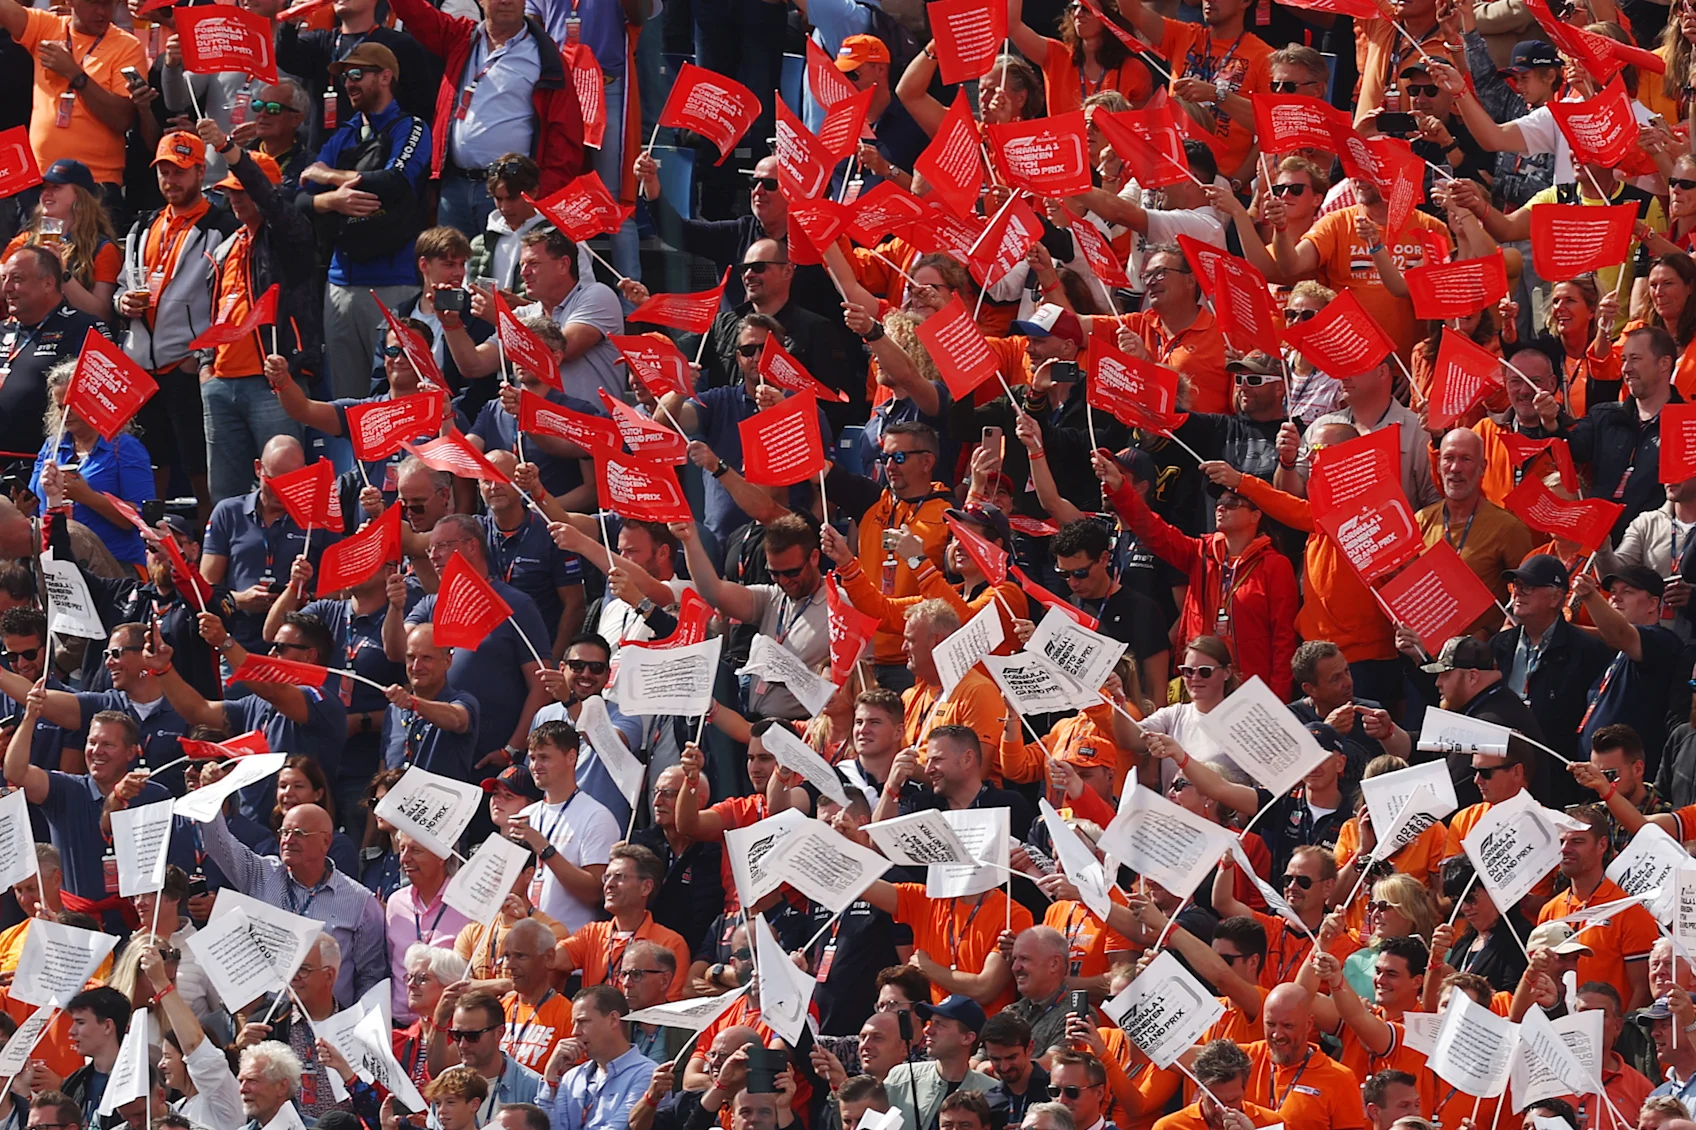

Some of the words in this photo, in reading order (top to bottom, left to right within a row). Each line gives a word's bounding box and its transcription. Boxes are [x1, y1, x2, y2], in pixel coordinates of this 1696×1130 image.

[195, 32, 243, 41] HEINEKEN
[197, 38, 230, 47] DUTCH
[198, 45, 233, 54] GRAND
[233, 48, 253, 56] PRIX
[717, 116, 737, 136] PRIX
[1041, 164, 1065, 175] PRIX
[644, 433, 665, 442] PRIX
[637, 493, 662, 501] PRIX
[1342, 524, 1382, 550] HEINEKEN
[1347, 537, 1374, 559] DUTCH
[1352, 542, 1380, 565] GRAND
[1378, 532, 1398, 550] PRIX
[1015, 686, 1046, 696] GRAND
[433, 805, 449, 823] PRIX
[1493, 856, 1519, 884] GRAND
[1516, 844, 1535, 862] PRIX
[1122, 1002, 1159, 1031] ORMULA
[1157, 995, 1165, 1003] 1
[1162, 1008, 1186, 1030] PRIX
